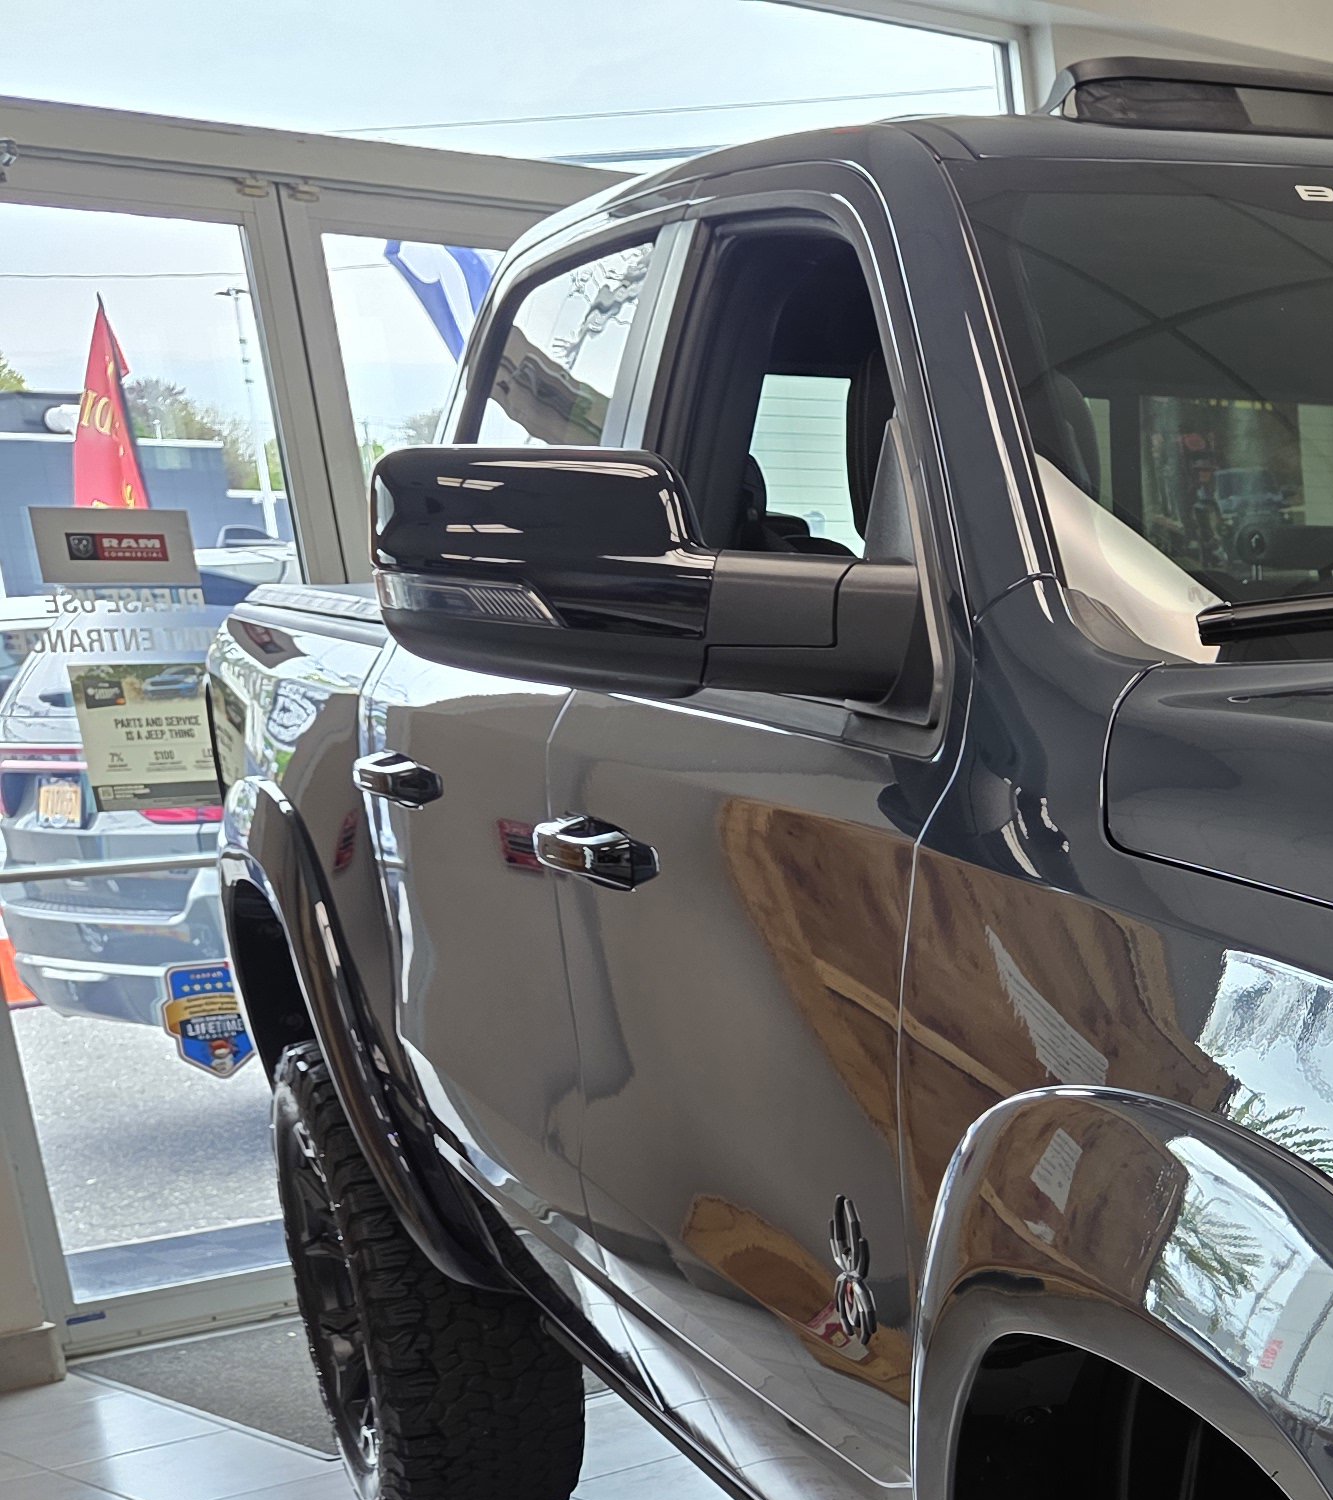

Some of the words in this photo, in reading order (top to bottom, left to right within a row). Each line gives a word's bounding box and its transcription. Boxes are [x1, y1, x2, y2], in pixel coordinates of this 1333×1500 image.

[101, 538, 161, 548] RAM
[114, 717, 144, 729] PARTS
[145, 716, 163, 728] AND
[164, 715, 202, 726] SERVICE
[125, 730, 135, 741] IS
[137, 730, 143, 740] A
[145, 729, 166, 741] JEEP
[168, 728, 196, 739] THING
[186, 1018, 245, 1037] LIFETIME
